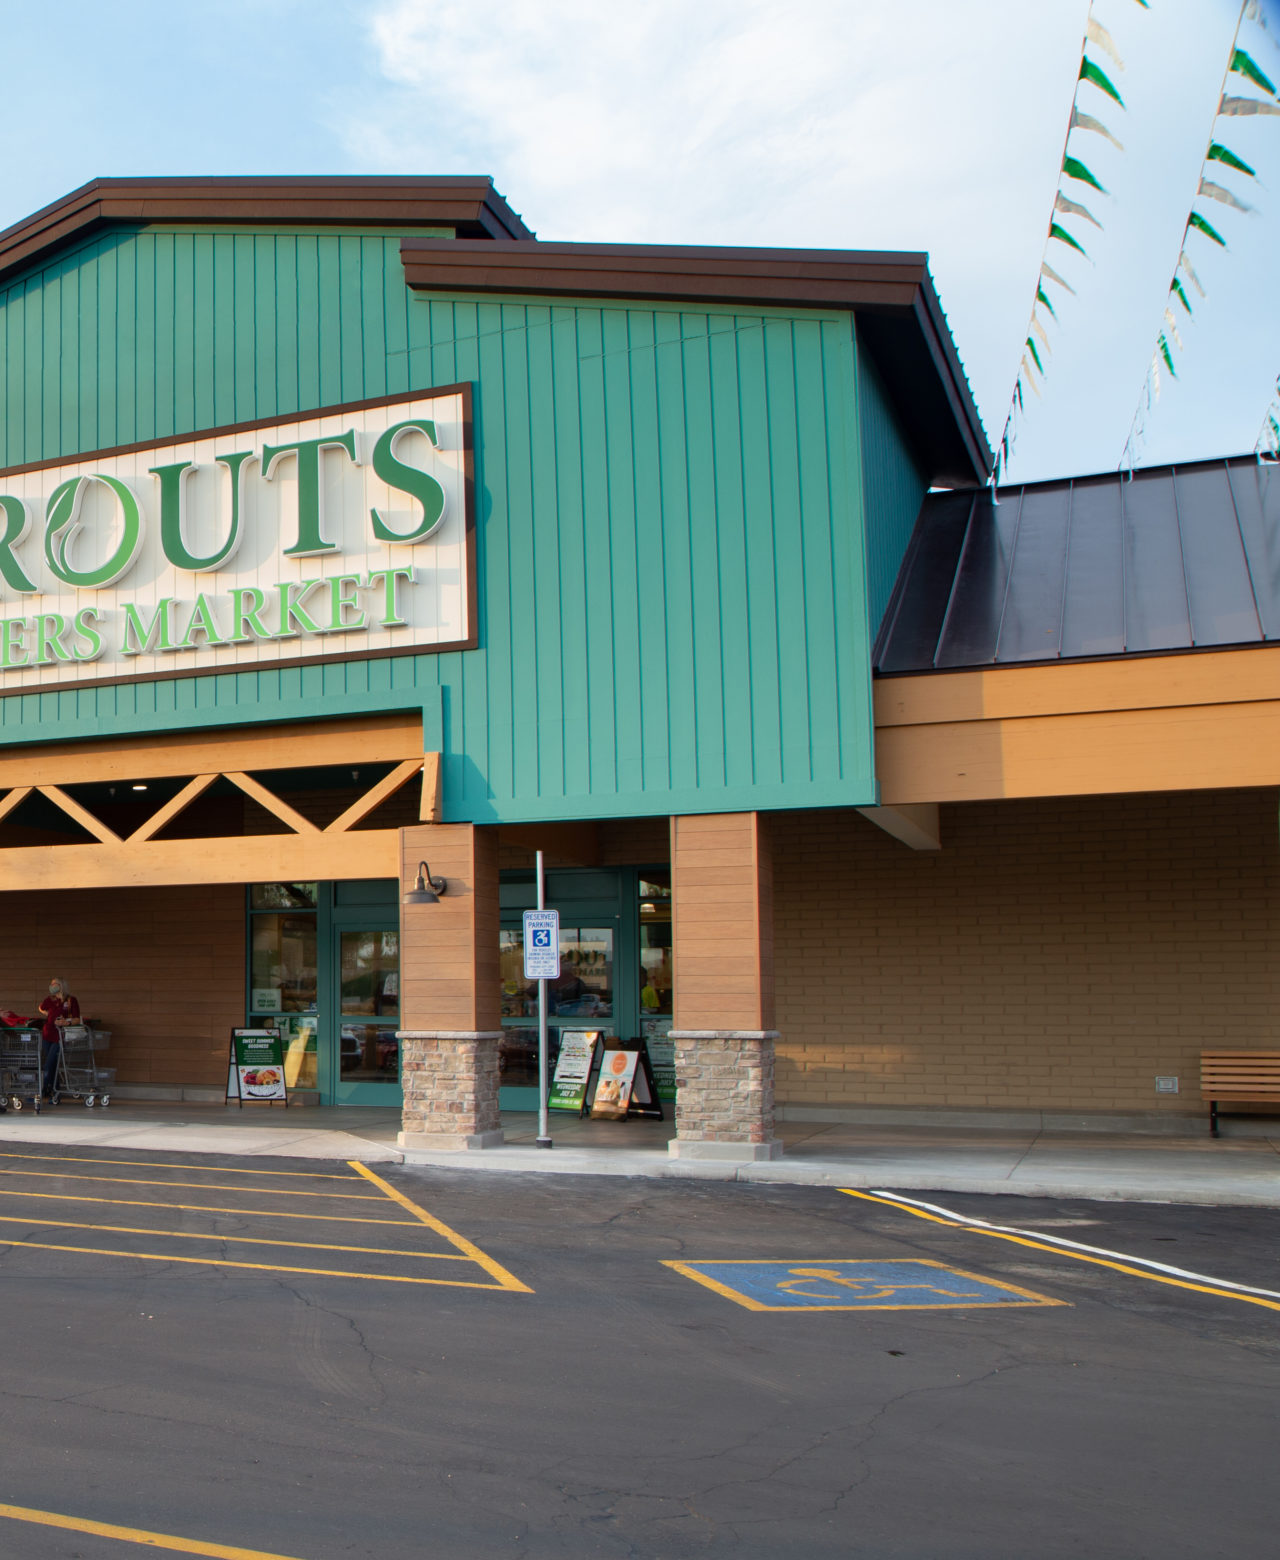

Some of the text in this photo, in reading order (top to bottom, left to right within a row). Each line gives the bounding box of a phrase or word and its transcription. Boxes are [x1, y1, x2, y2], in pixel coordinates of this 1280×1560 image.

[119, 565, 418, 656] MARKET
[524, 913, 556, 921] RESERVED
[528, 921, 554, 929] PARKING
